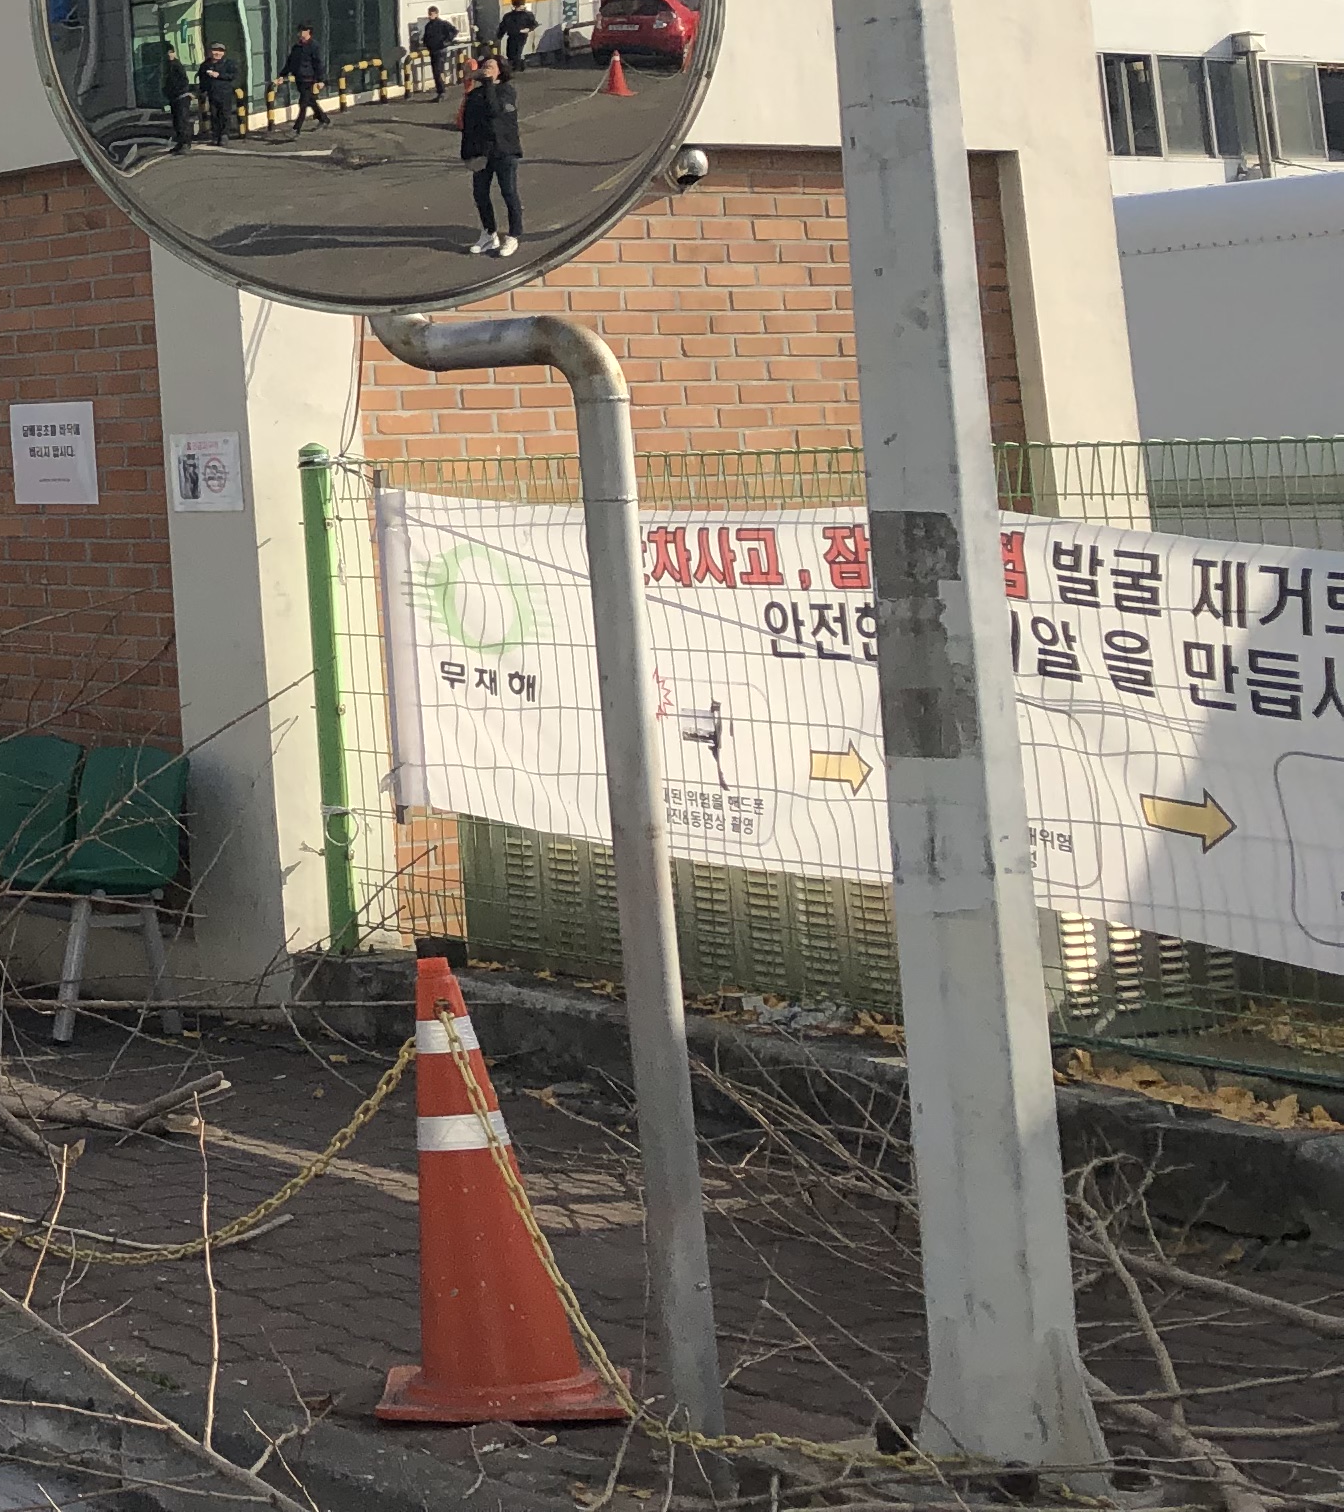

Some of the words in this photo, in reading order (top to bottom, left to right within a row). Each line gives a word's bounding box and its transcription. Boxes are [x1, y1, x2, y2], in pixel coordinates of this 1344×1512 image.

[1052, 540, 1163, 617] 발굴
[687, 790, 724, 811] 위험을
[727, 795, 765, 816] 핸드폰
